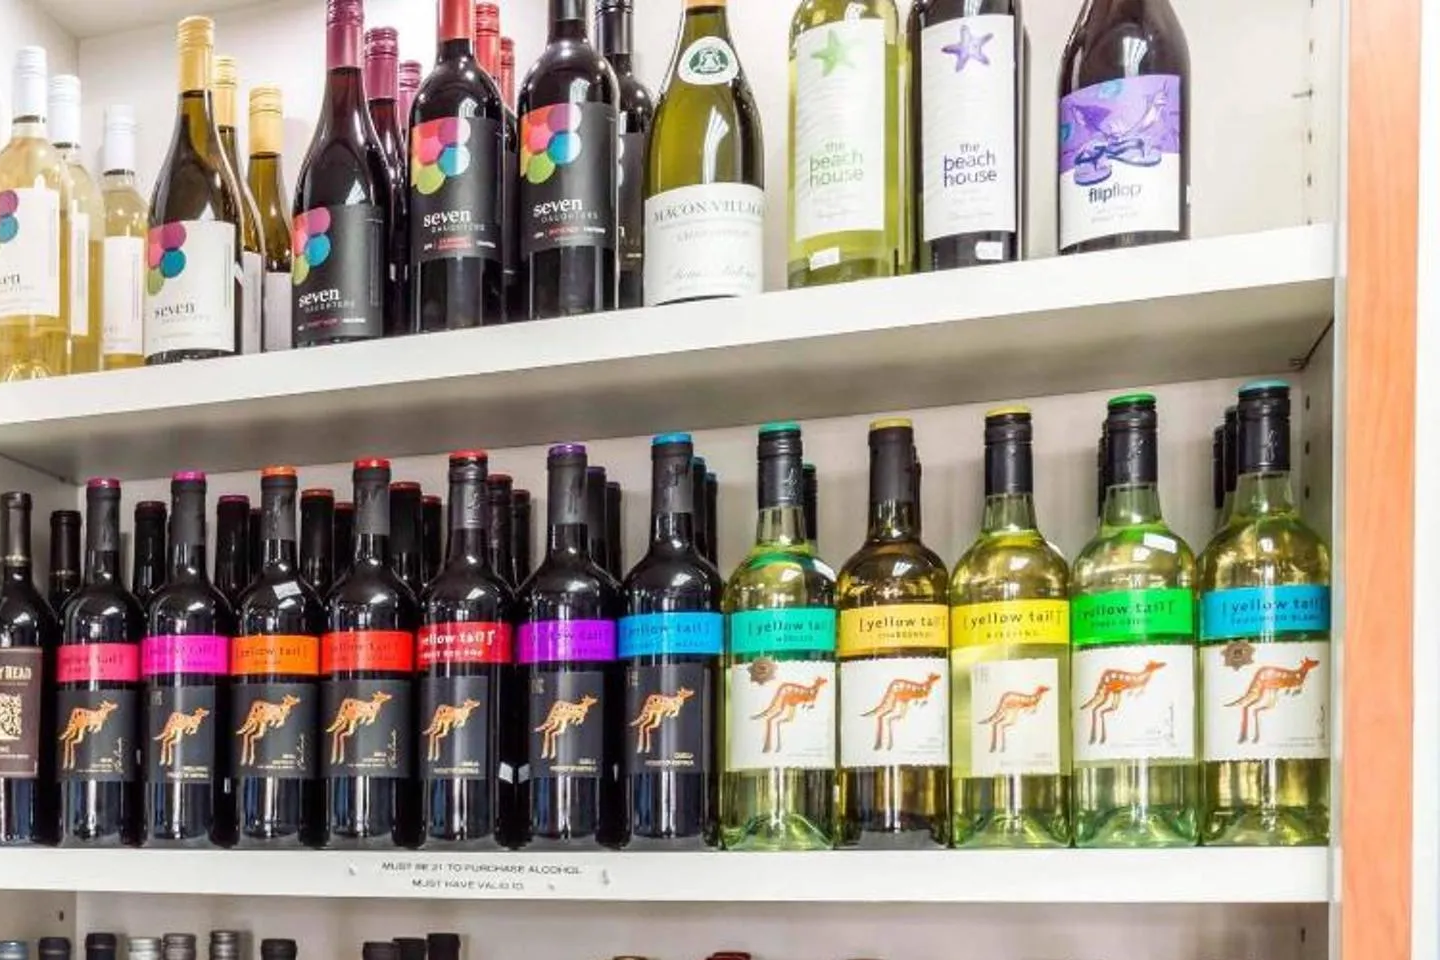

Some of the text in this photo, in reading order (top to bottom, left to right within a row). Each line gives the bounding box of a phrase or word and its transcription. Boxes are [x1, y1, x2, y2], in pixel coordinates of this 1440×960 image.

[960, 142, 981, 154] the
[810, 151, 864, 172] beach
[944, 151, 996, 172] beach
[809, 168, 864, 187] house
[944, 167, 998, 187] house
[533, 198, 583, 217] seven
[423, 208, 472, 226] seven
[298, 287, 340, 305] seven
[154, 302, 195, 320] seven
[755, 619, 804, 635] yellow
[867, 617, 916, 632] yellow
[971, 609, 1052, 628] yellow tail
[447, 864, 462, 872] TO
[464, 863, 525, 874] PURCHASE
[528, 865, 583, 875] ALCOHOL
[444, 880, 474, 889] HAVE
